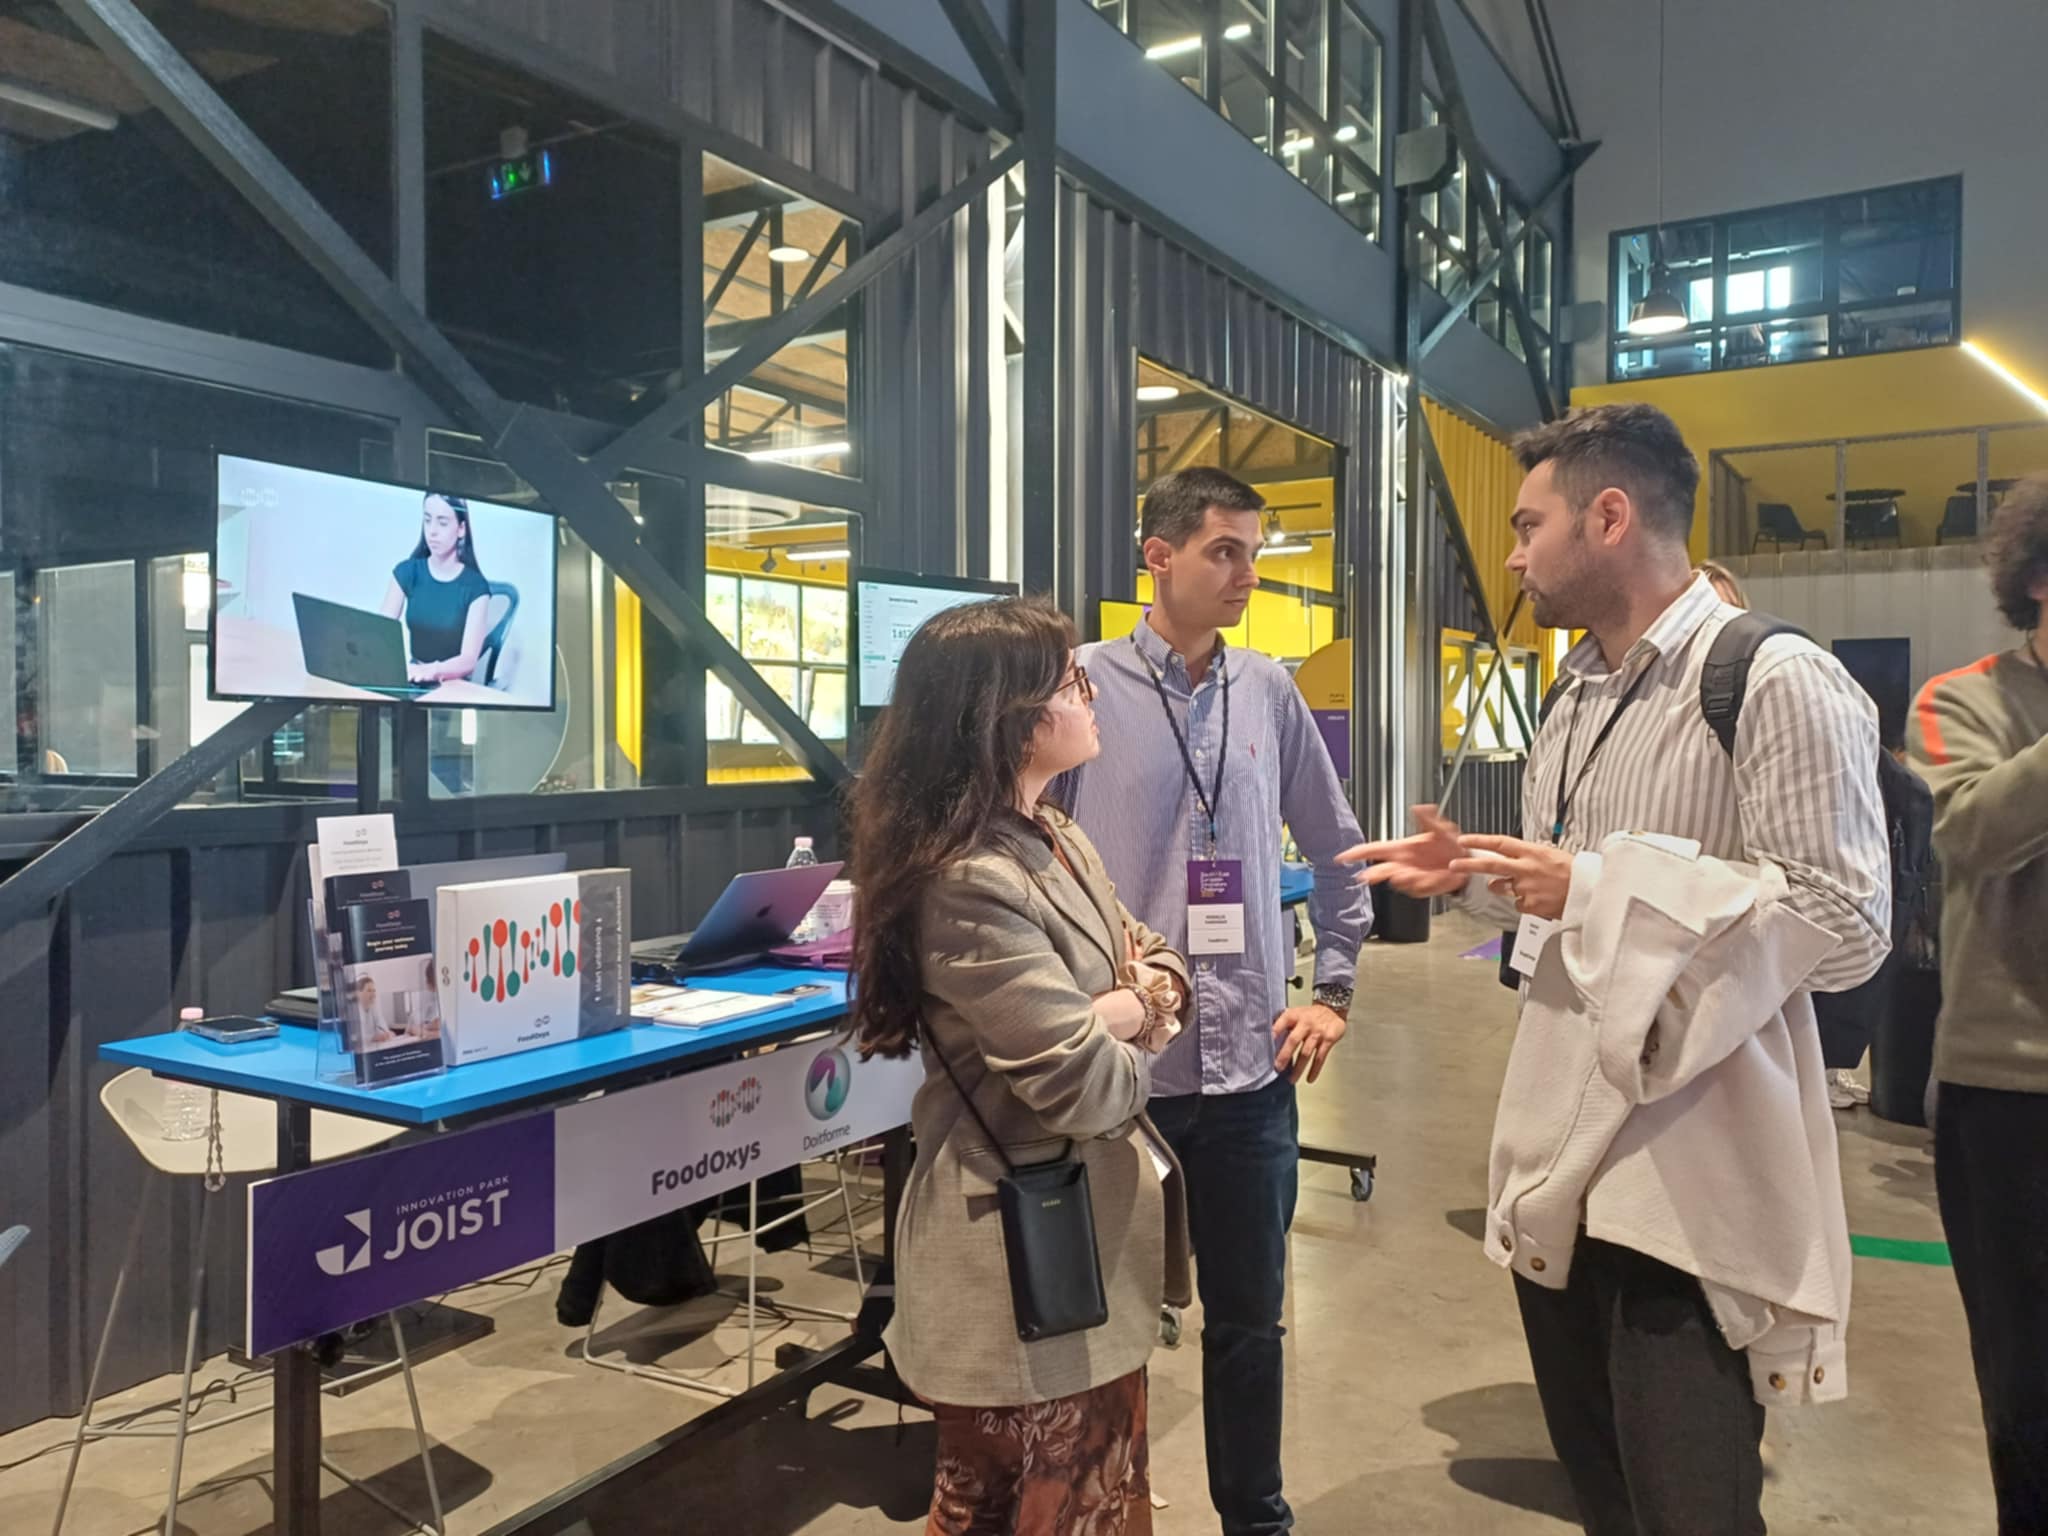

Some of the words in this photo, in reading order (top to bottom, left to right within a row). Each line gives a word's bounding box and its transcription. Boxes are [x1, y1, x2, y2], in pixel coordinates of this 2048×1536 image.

[803, 1124, 851, 1151] Doitforme
[651, 1140, 761, 1196] FoodOxys
[396, 1185, 474, 1216] INNOVATION
[479, 1175, 509, 1190] PARK
[383, 1187, 510, 1261] JOIST
